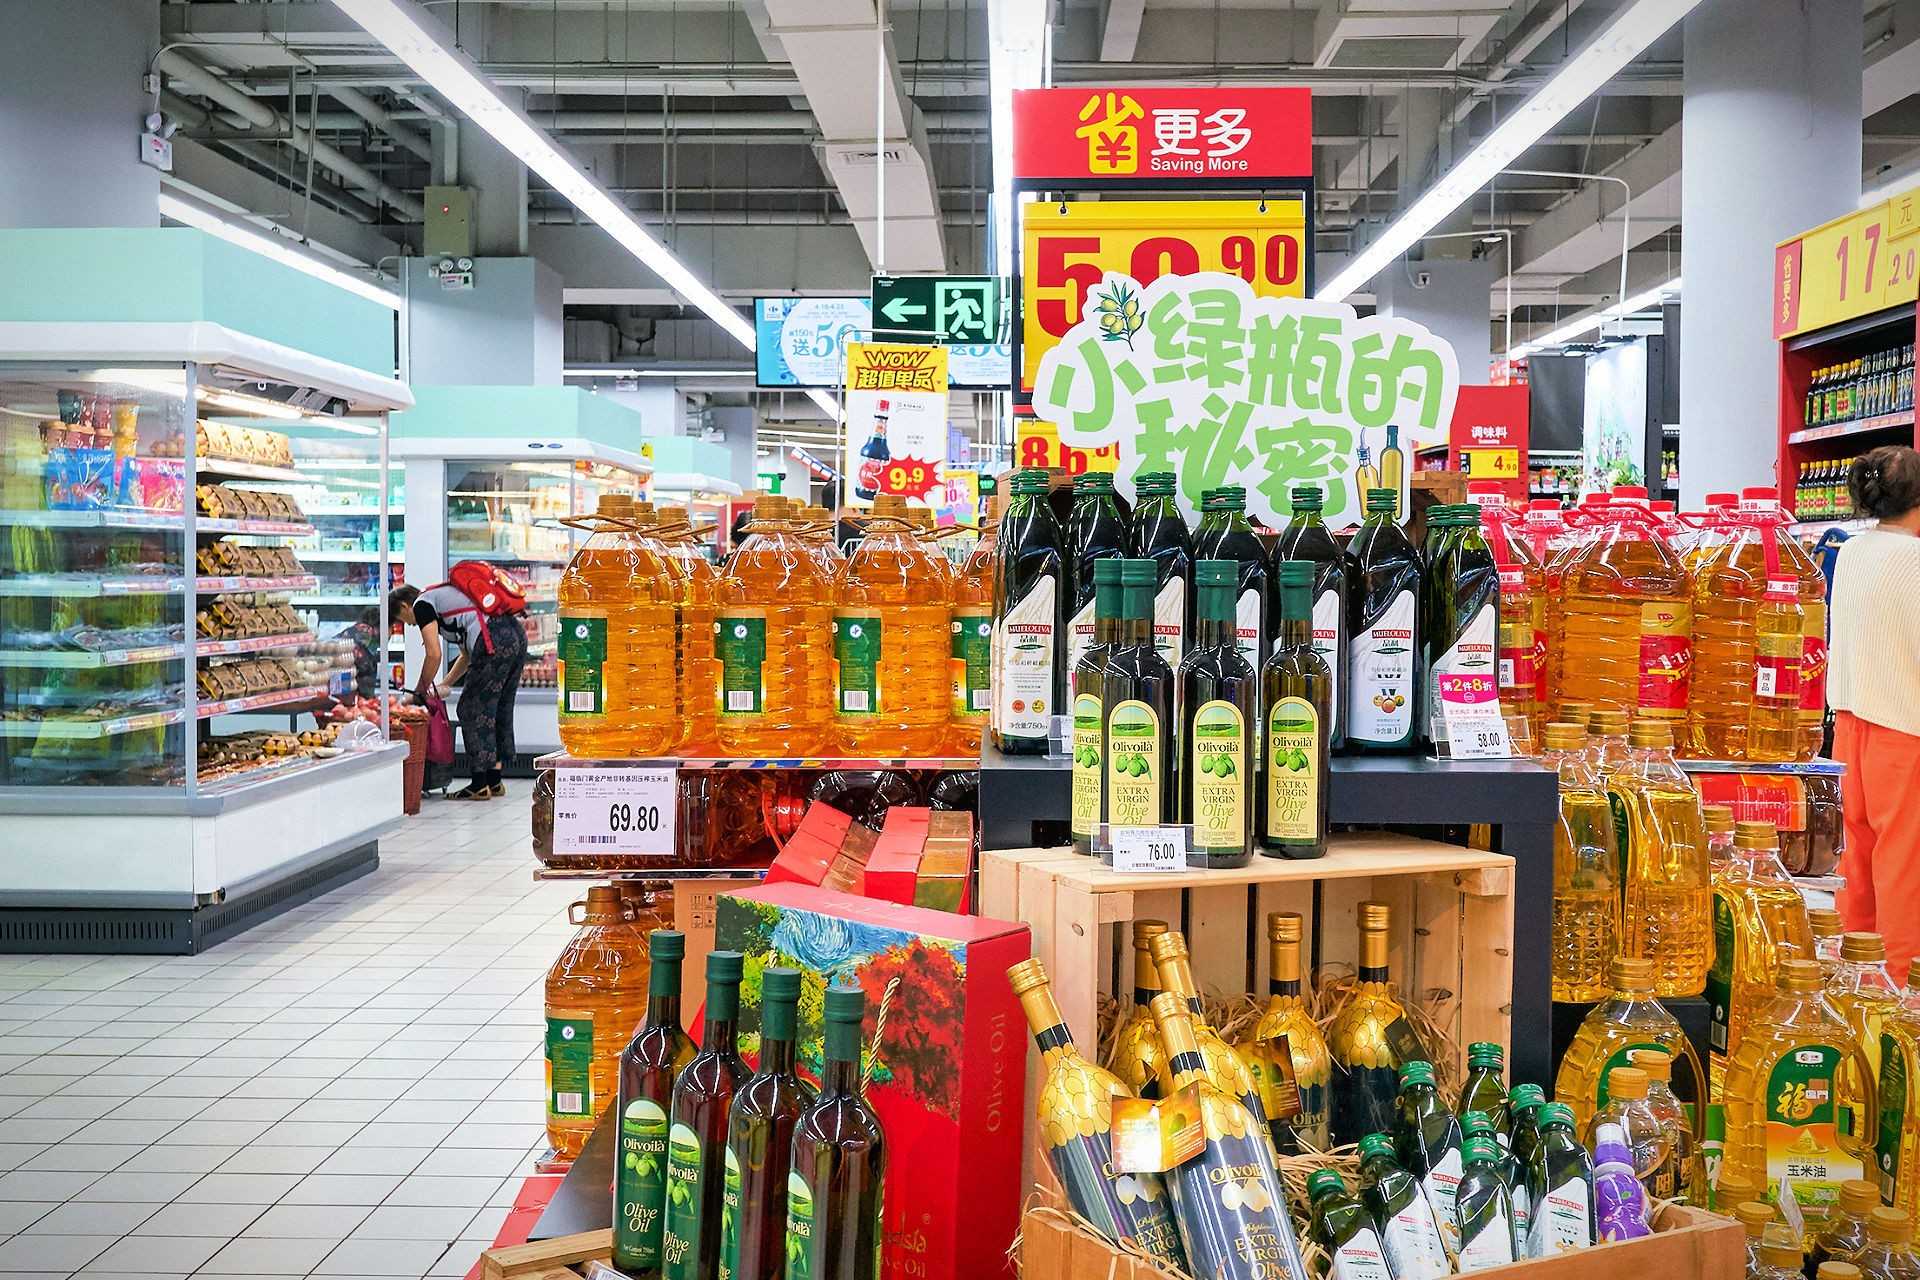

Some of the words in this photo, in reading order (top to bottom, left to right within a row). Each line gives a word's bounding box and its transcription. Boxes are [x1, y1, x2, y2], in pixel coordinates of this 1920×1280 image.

[1150, 157, 1204, 174] Saving
[1208, 157, 1249, 171] More
[1900, 197, 1913, 225] 元
[792, 339, 810, 356] 送
[865, 351, 930, 368] WOW
[1049, 289, 1444, 433] 小绿瓶的
[857, 368, 935, 391] 超值单品
[1471, 426, 1508, 438] 调味料
[1132, 393, 1353, 517] 秘密
[889, 467, 925, 491] 9.9
[1442, 678, 1493, 692] 第2件8折
[1112, 741, 1153, 752] Olivoilà
[1197, 741, 1239, 752] Olivoilà
[1272, 736, 1313, 747] Olivoilà
[1477, 732, 1501, 748] 58.00
[1116, 786, 1150, 795] EXTRA
[1202, 787, 1236, 795] EXTRA
[1276, 780, 1308, 789] EXTRA
[1276, 788, 1308, 796] VIRGIN
[1117, 795, 1150, 803] VIRGIN
[1275, 796, 1308, 809] Olive
[1116, 802, 1149, 817] Olive
[1202, 804, 1235, 817] Olive
[1281, 809, 1301, 822] Oil
[609, 803, 660, 832] 69.80
[1208, 817, 1228, 830] Oil
[1148, 843, 1176, 861] 76.00
[623, 1137, 666, 1152] Olivoilà
[1787, 1164, 1827, 1178] 玉米油
[624, 1201, 658, 1219] Olive
[629, 1217, 651, 1233] Oil
[665, 1247, 682, 1265] Oil
